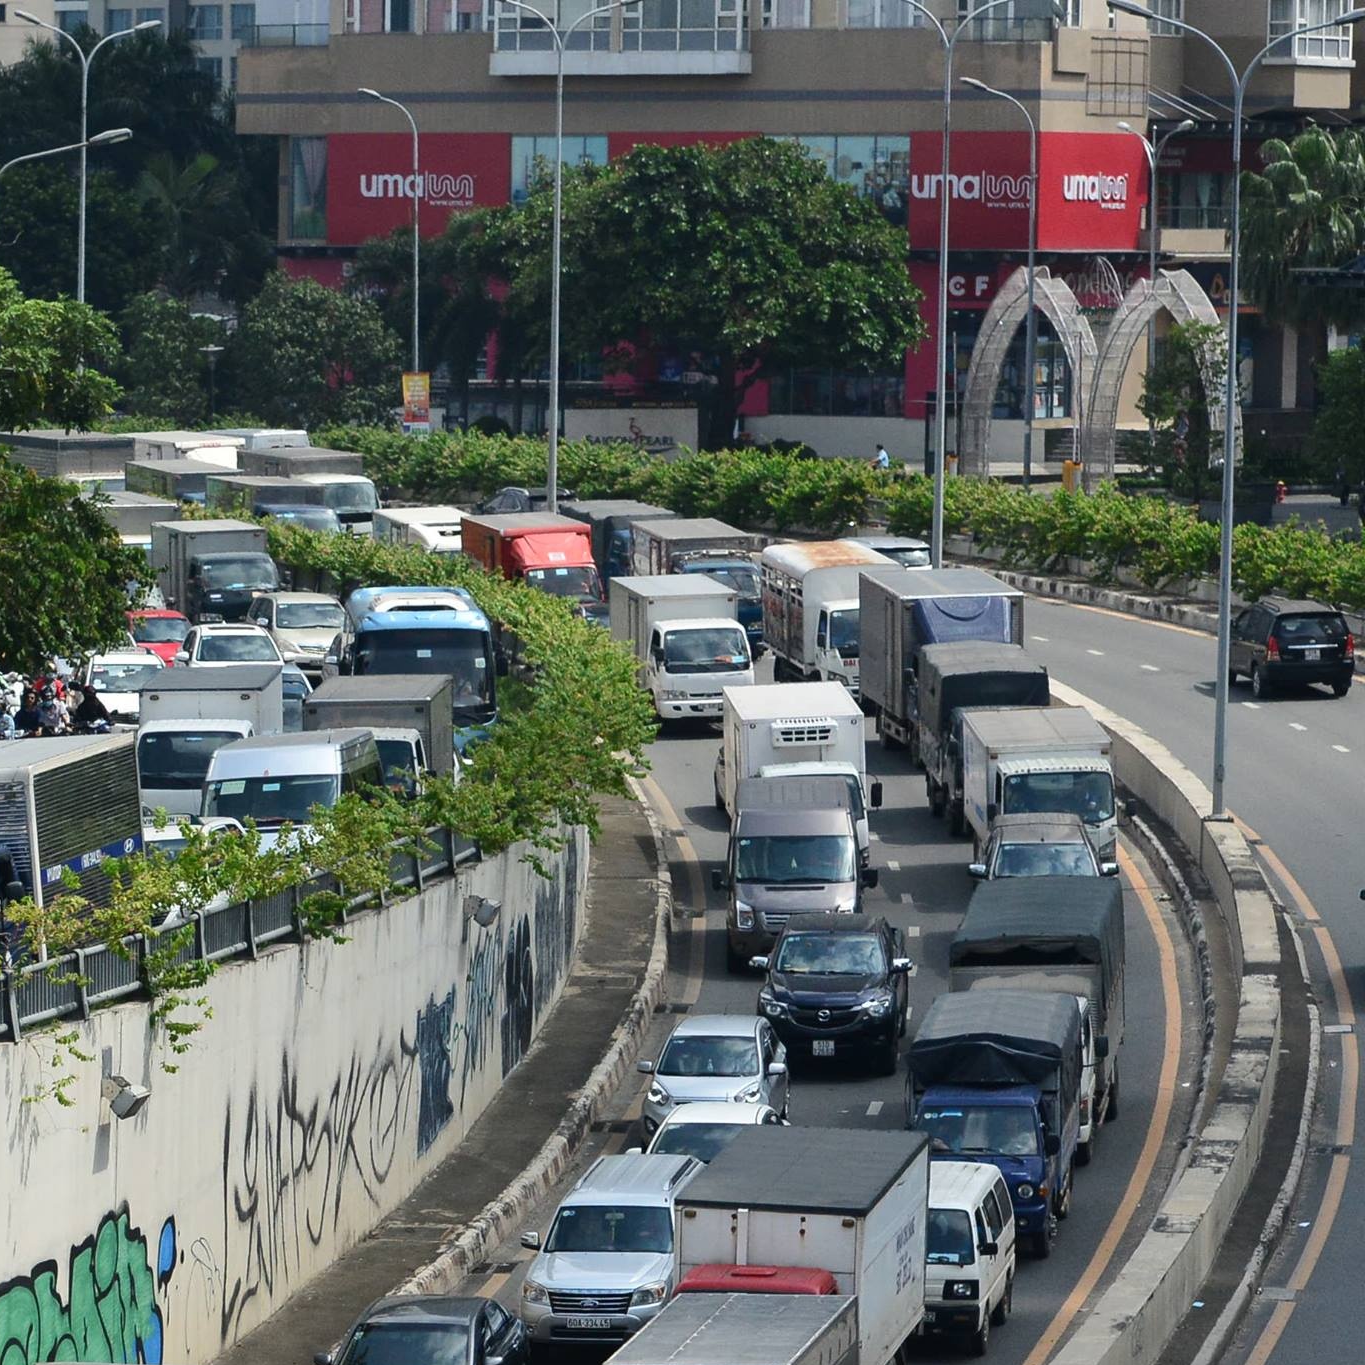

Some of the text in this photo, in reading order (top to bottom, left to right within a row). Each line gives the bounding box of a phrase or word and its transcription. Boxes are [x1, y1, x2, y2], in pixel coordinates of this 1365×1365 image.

[360, 174, 424, 198] uma
[912, 174, 981, 199] uma
[1064, 174, 1100, 201] uma
